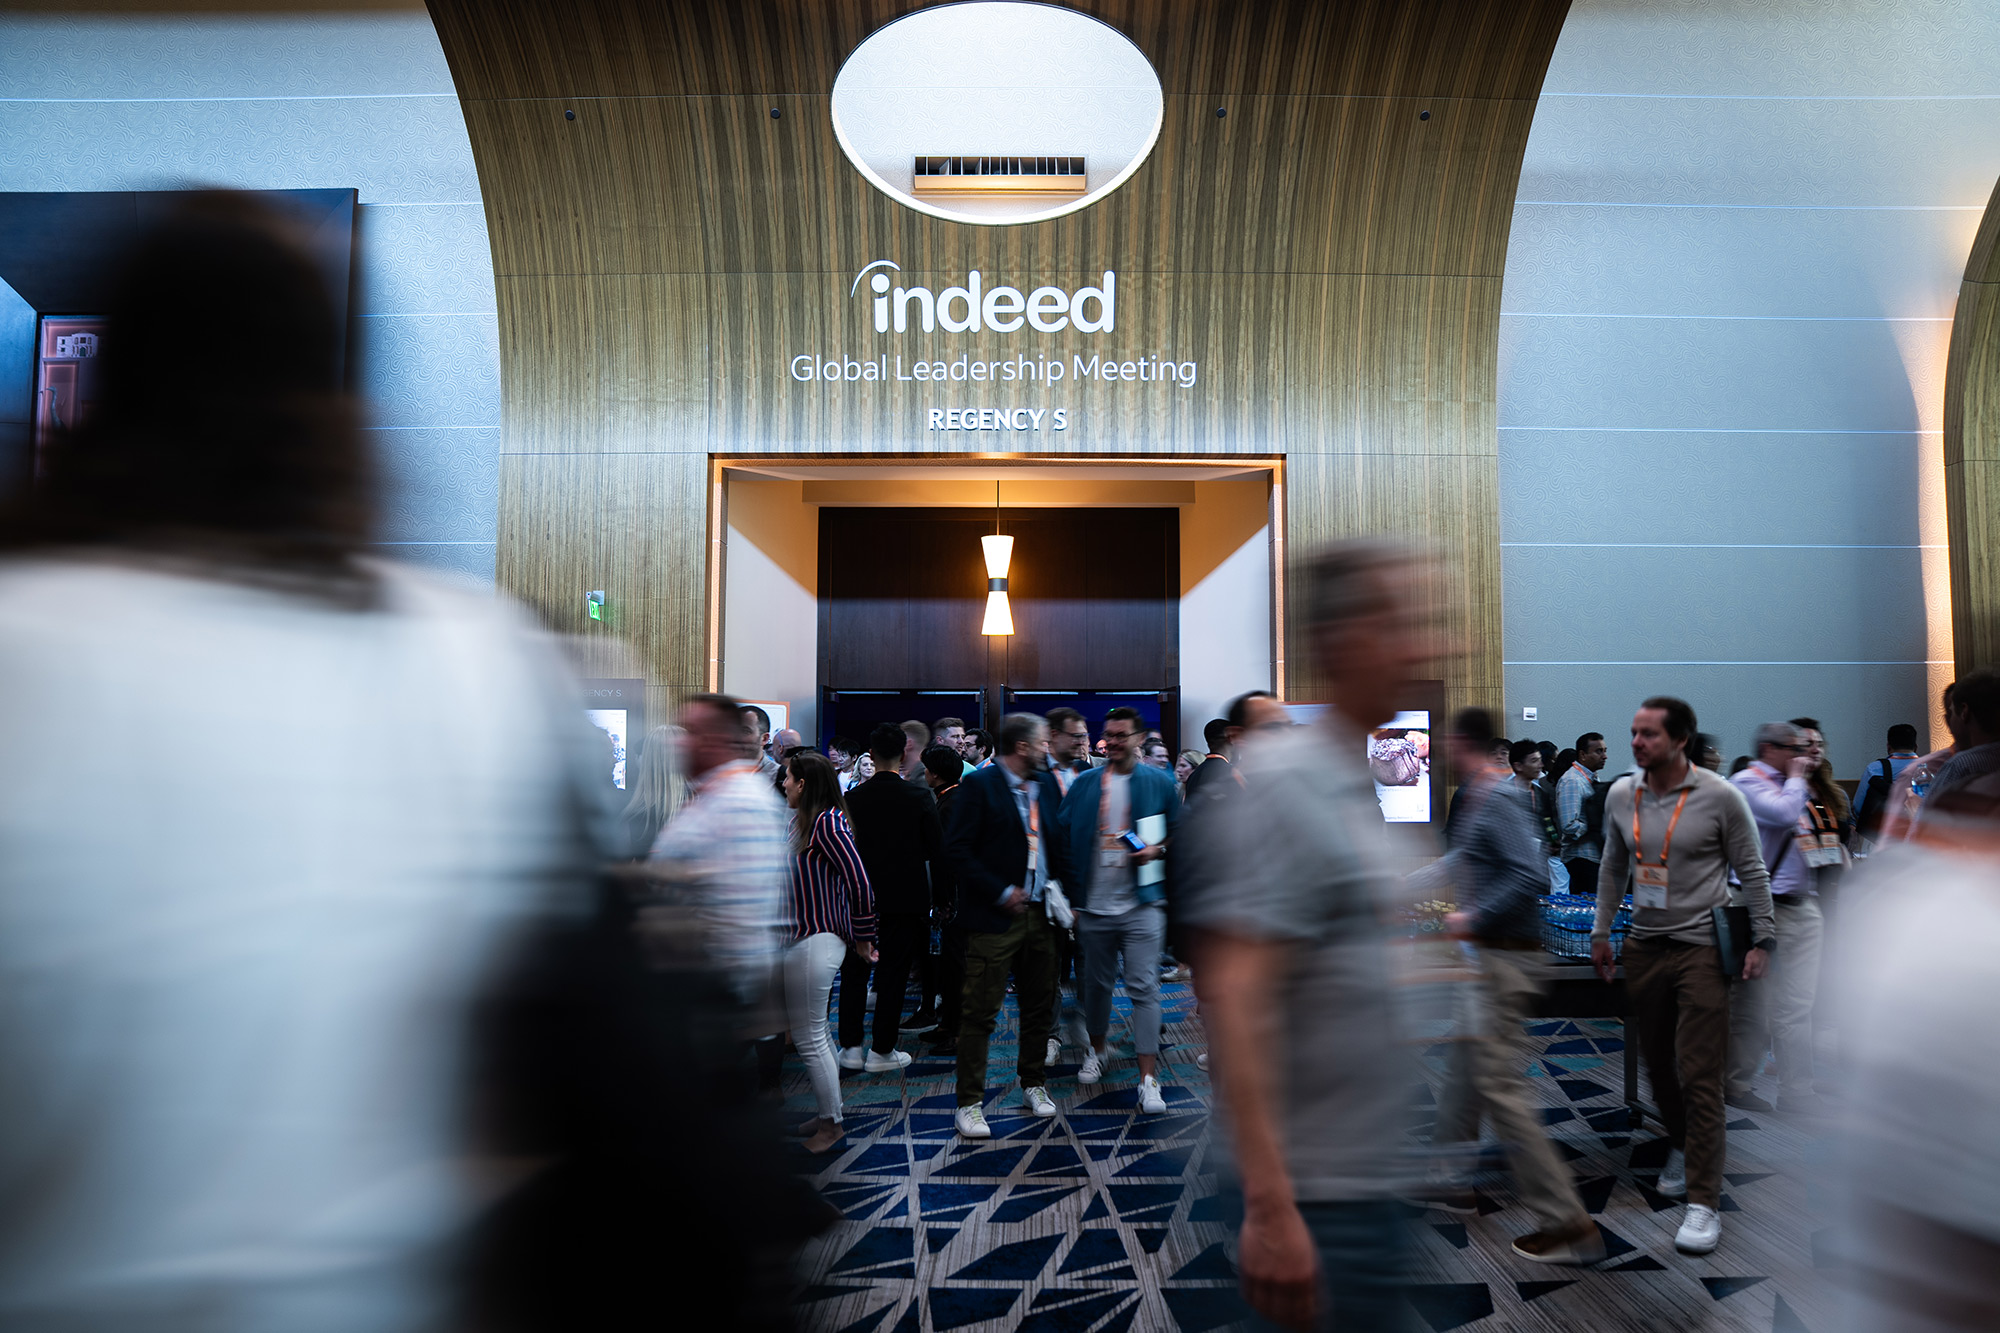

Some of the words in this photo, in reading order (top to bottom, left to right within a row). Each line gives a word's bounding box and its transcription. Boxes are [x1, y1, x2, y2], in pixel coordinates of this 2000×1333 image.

[851, 260, 1115, 333] indeed
[790, 354, 887, 382] Global
[895, 354, 1065, 387] Leadership
[1073, 354, 1198, 388] Meeting
[928, 408, 1046, 431] REGENCY
[1053, 408, 1068, 431] S
